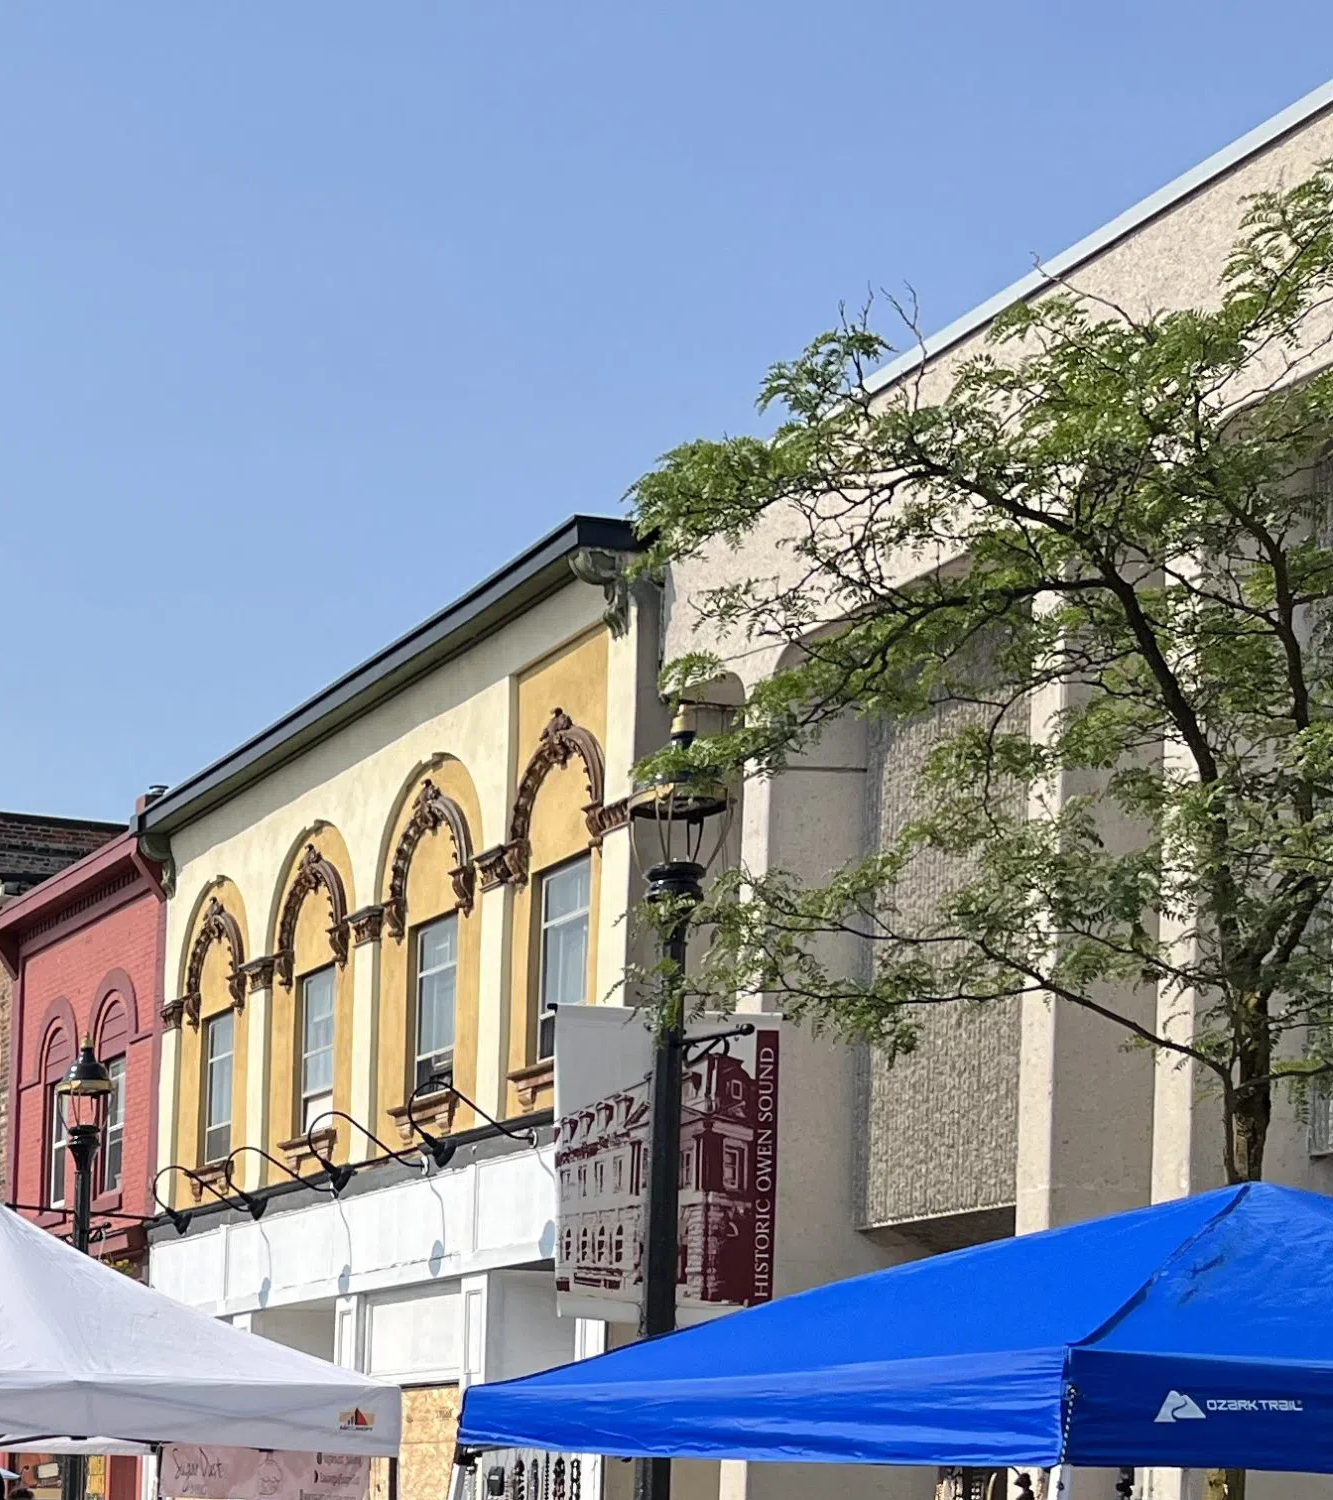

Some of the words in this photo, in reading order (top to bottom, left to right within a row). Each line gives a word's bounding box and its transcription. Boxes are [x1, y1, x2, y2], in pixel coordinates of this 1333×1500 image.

[758, 1047, 774, 1122] SOUND
[756, 1128, 773, 1193] OWEN
[754, 1198, 771, 1298] HISTORIC
